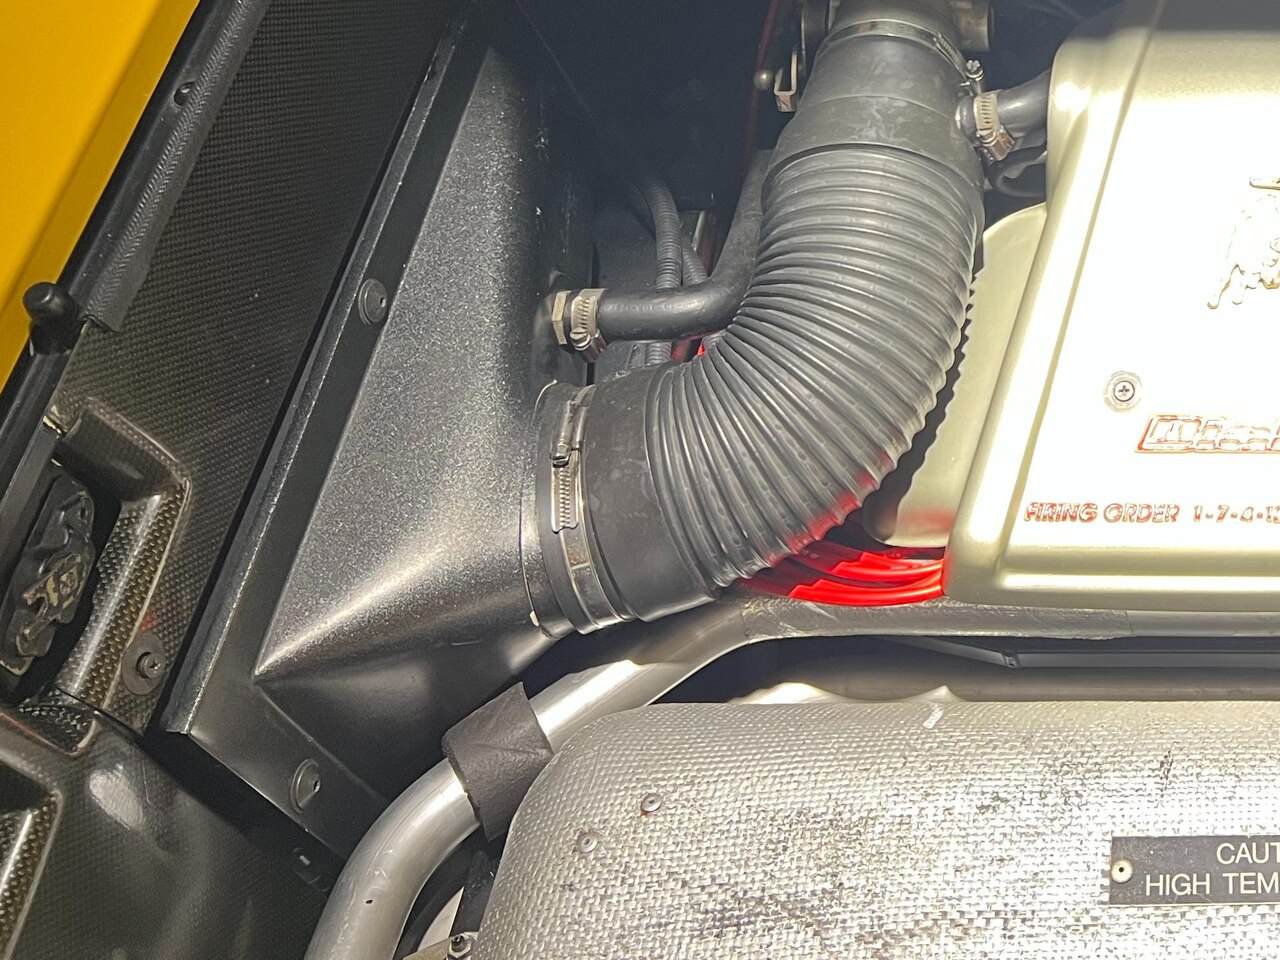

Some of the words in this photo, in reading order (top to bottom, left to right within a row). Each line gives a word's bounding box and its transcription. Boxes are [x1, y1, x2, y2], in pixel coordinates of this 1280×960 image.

[1024, 502, 1098, 523] FIRING
[1103, 502, 1181, 523] ORDER
[1145, 872, 1211, 896] HIGH
